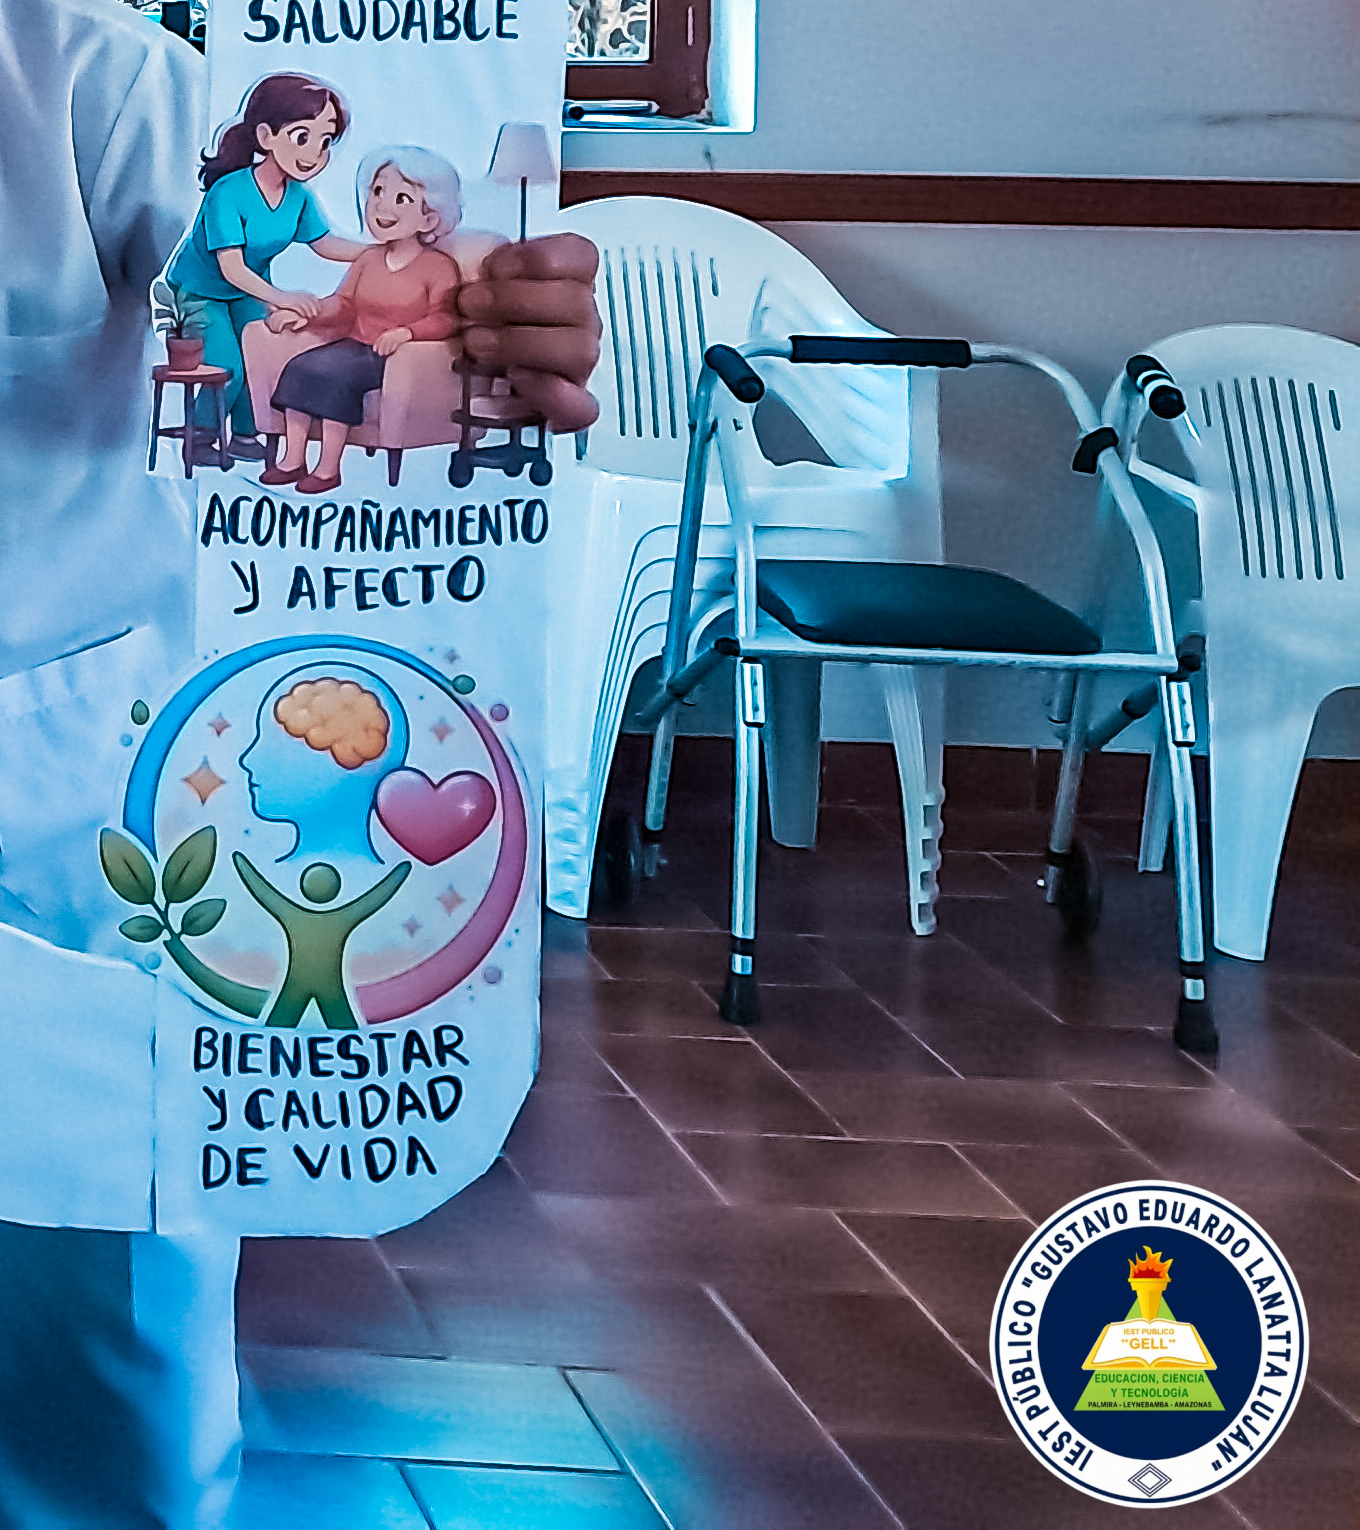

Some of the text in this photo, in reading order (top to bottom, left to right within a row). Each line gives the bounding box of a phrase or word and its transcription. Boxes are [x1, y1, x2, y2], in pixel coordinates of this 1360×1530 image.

[200, 493, 549, 552] ACOMPAÑAMIENTO
[287, 555, 485, 611] AFECTO
[193, 1025, 470, 1080] BIENESTAR
[244, 1075, 463, 1132] CALIDAD
[202, 1136, 437, 1189] DE VIDA
